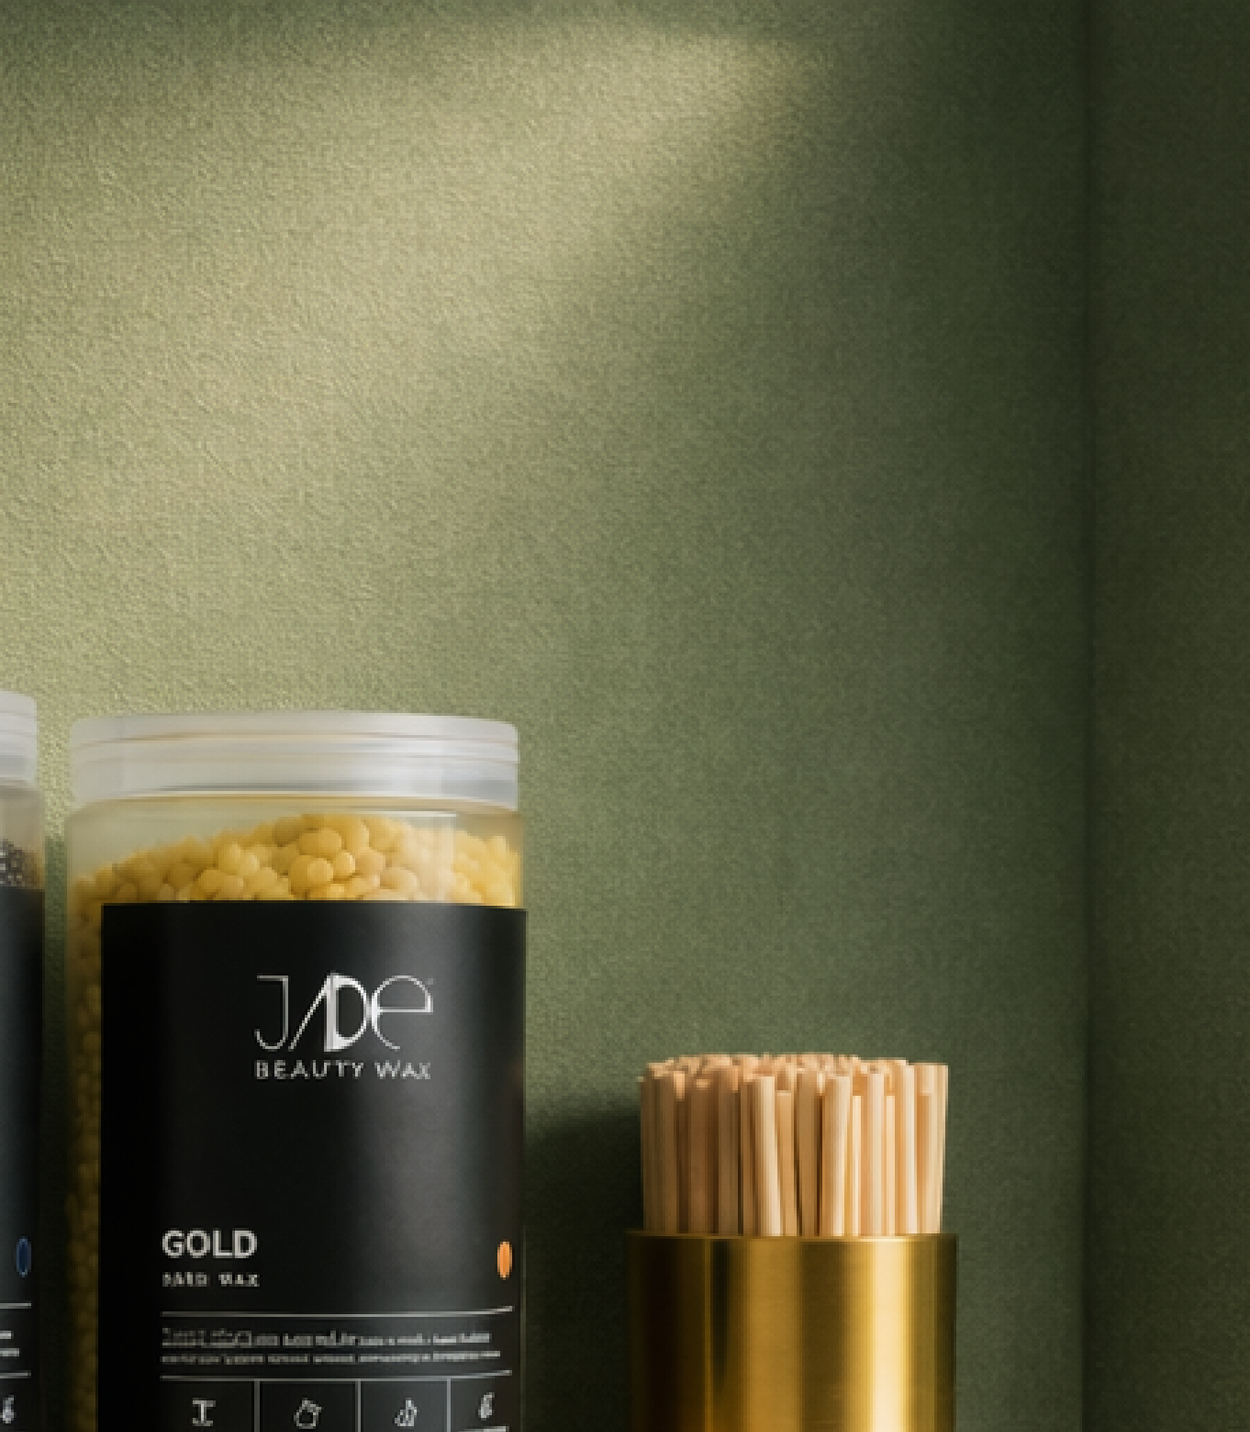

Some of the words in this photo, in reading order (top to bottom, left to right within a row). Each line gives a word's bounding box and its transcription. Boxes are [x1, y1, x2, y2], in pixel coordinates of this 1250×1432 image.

[255, 1059, 364, 1080] BEAUTY
[374, 1059, 431, 1080] WAX
[161, 1229, 258, 1259] GOLD
